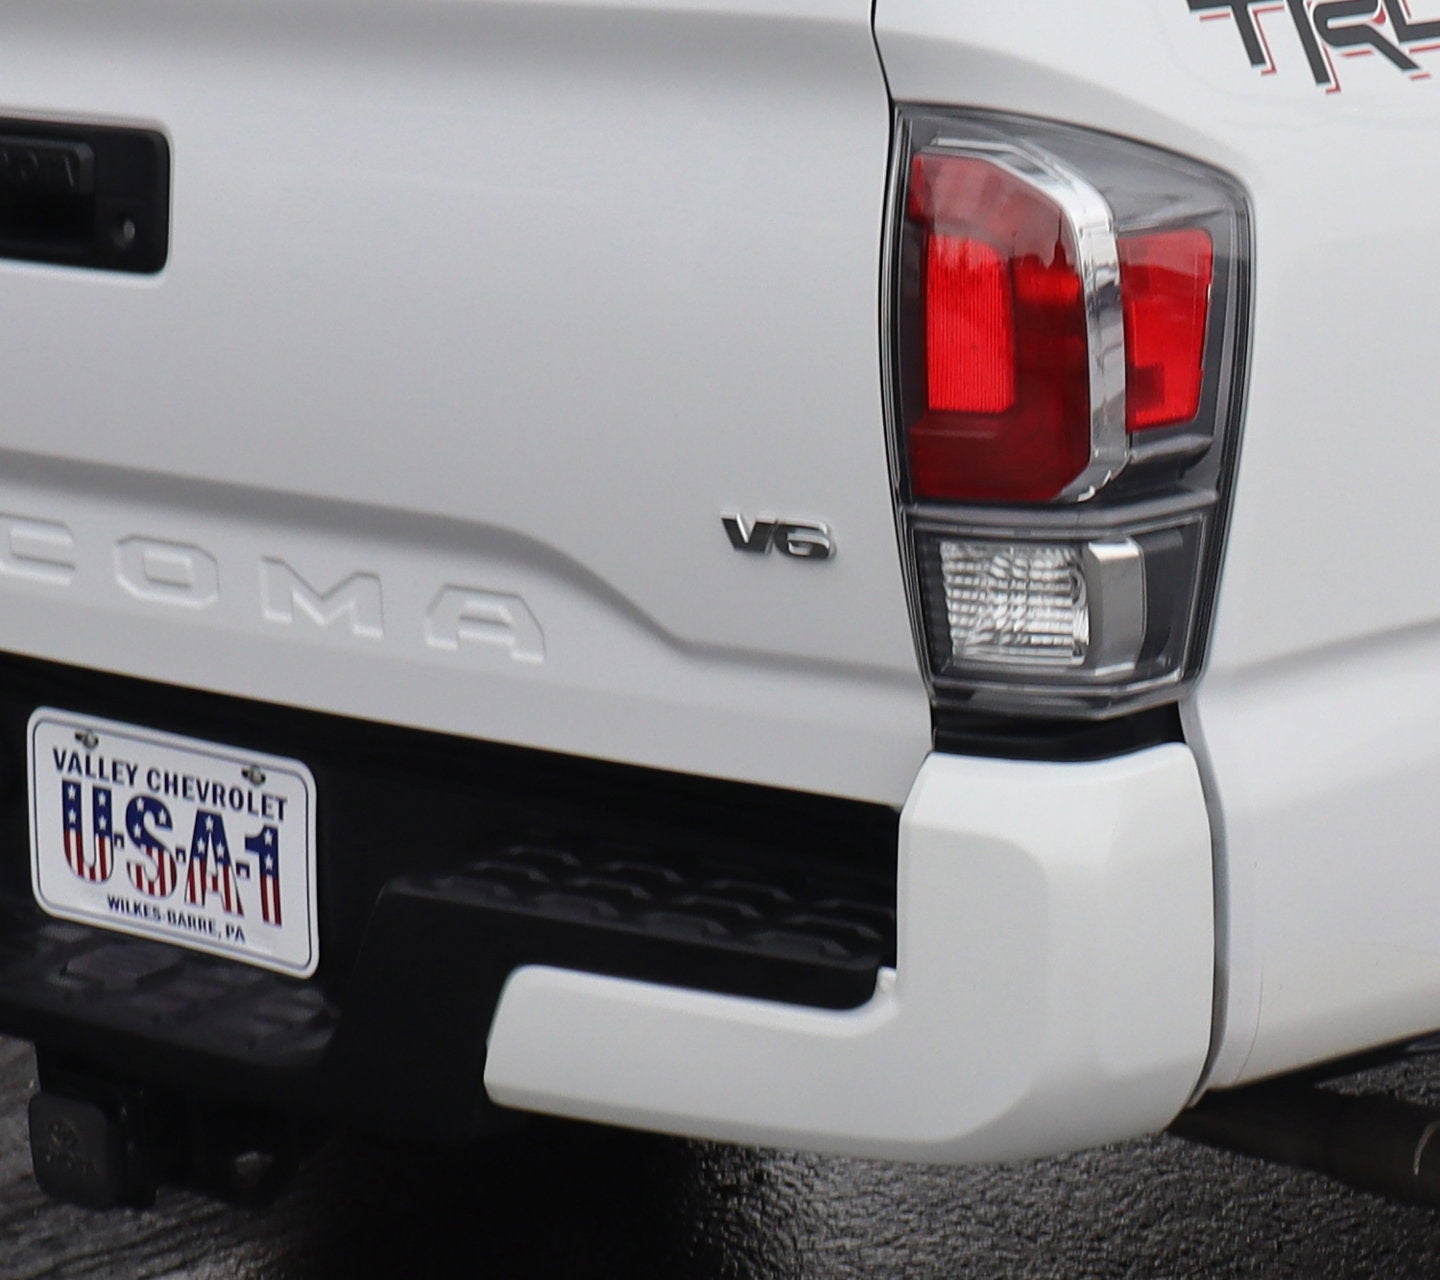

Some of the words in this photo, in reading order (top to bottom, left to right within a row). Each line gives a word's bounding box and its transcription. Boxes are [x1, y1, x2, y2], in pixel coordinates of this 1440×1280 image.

[720, 515, 836, 561] V6
[52, 746, 139, 788] VALLEY
[146, 767, 288, 821] CHEVROLET
[226, 924, 246, 942] PA
